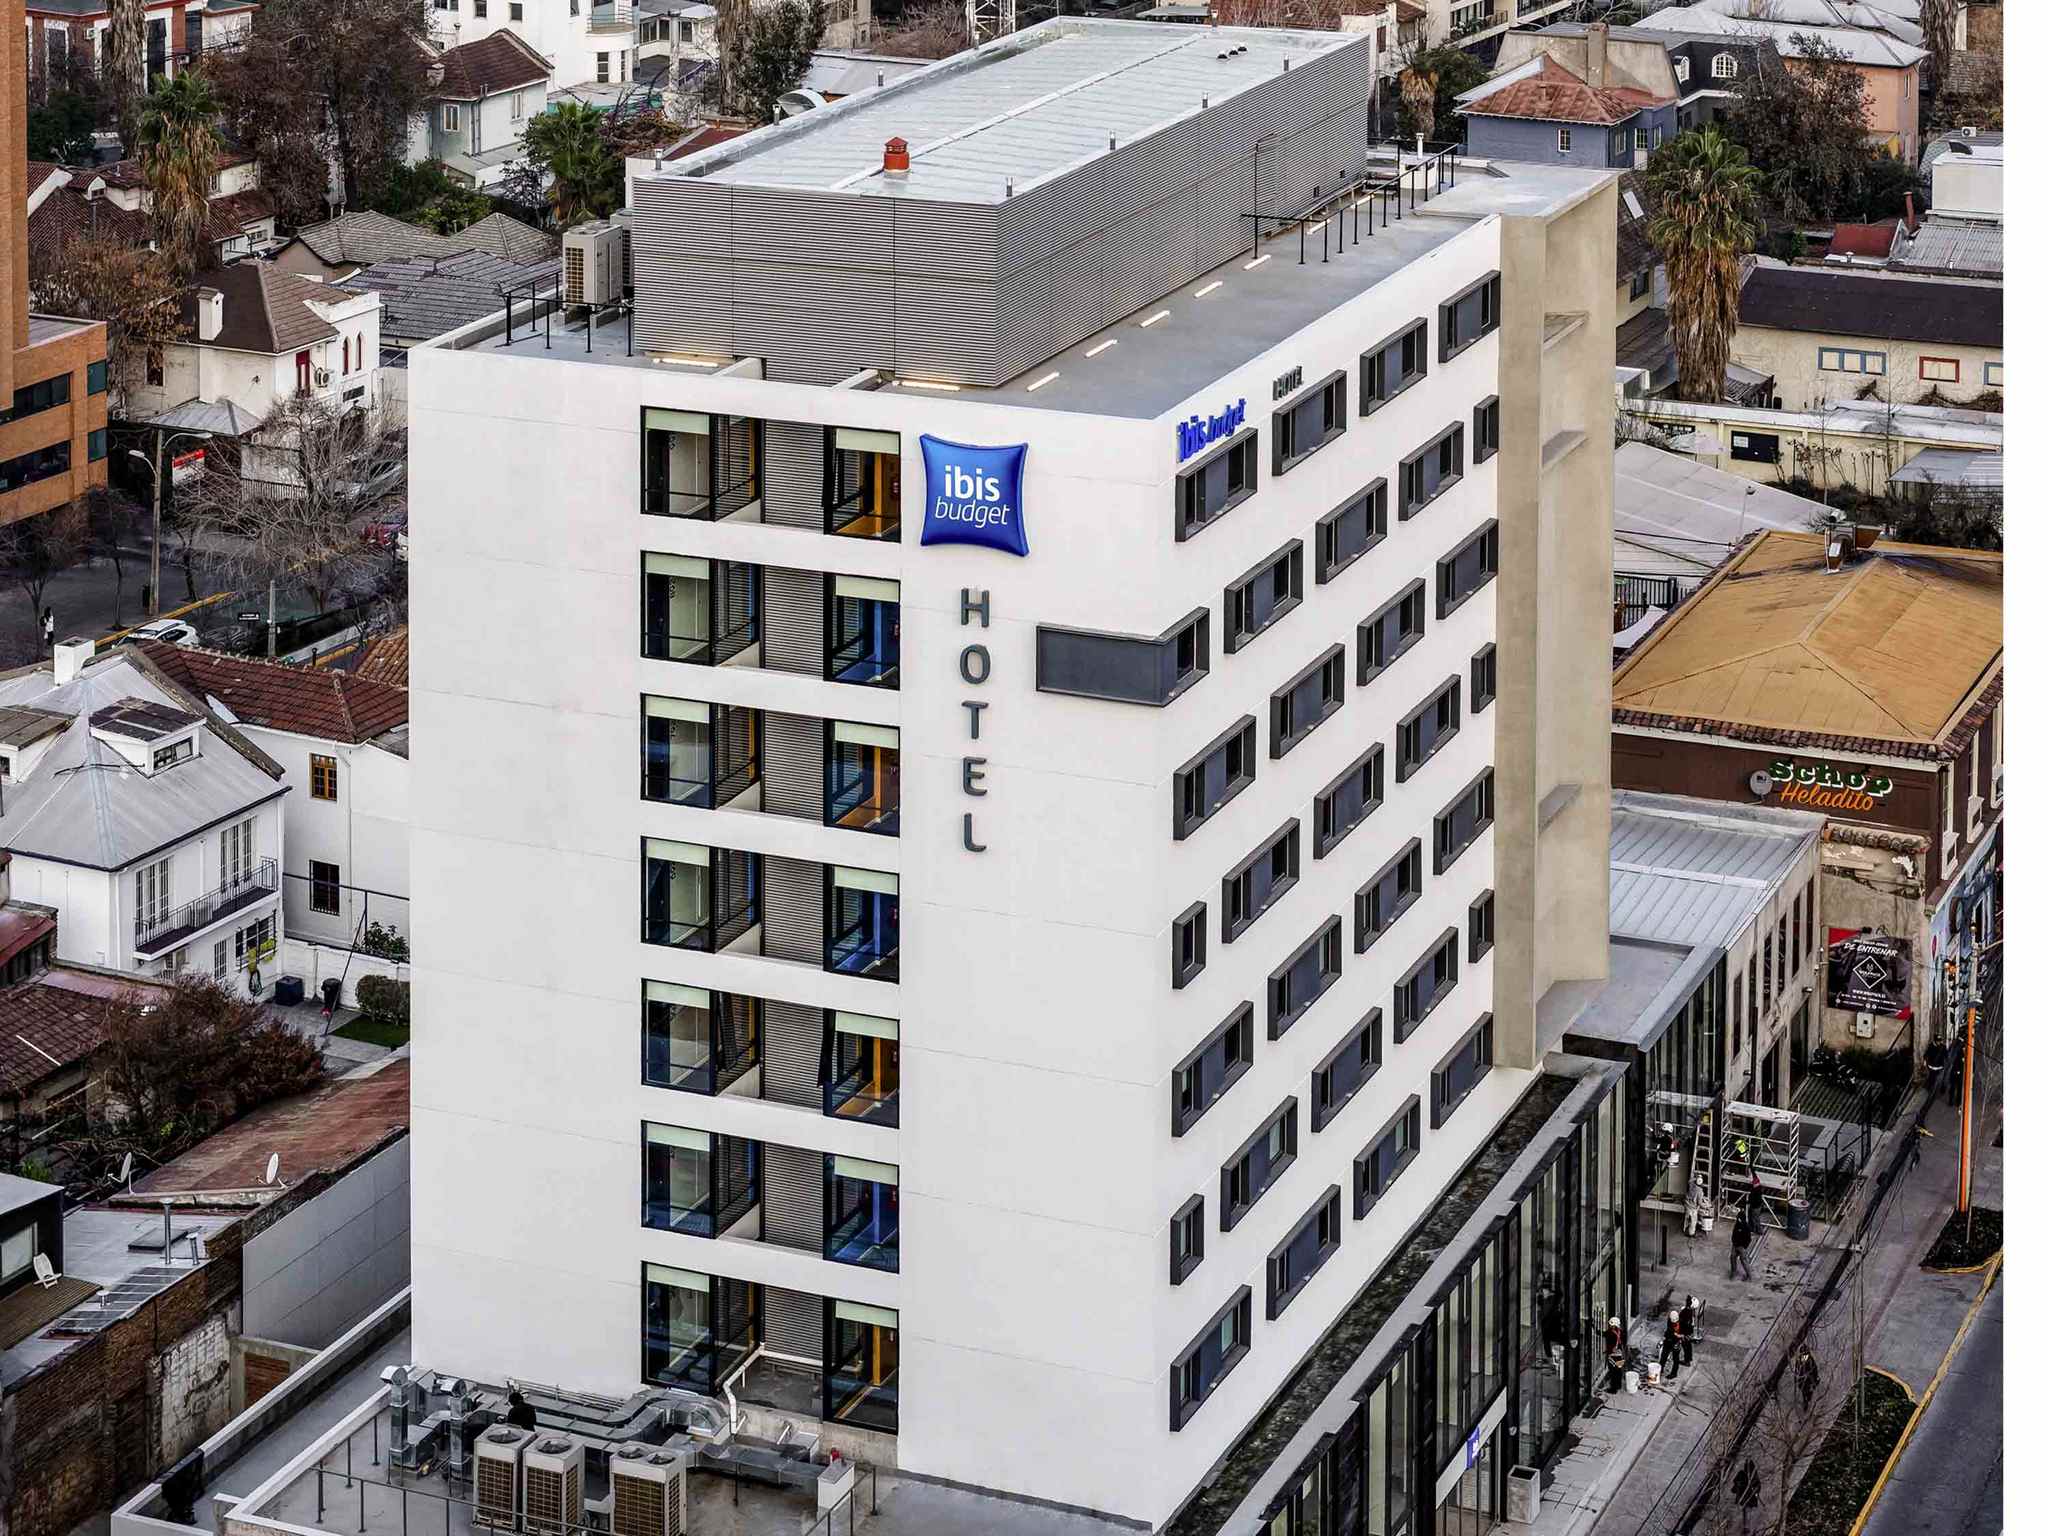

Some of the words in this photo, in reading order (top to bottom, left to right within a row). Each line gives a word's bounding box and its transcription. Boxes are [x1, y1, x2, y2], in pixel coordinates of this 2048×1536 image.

[1272, 365, 1303, 401] HOTEL
[1177, 415, 1207, 463] ibis
[1206, 398, 1247, 443] budget
[943, 465, 1001, 502] ibis
[935, 496, 1009, 529] budget
[960, 587, 992, 853] HOTEL
[1780, 783, 1874, 811] Heladito
